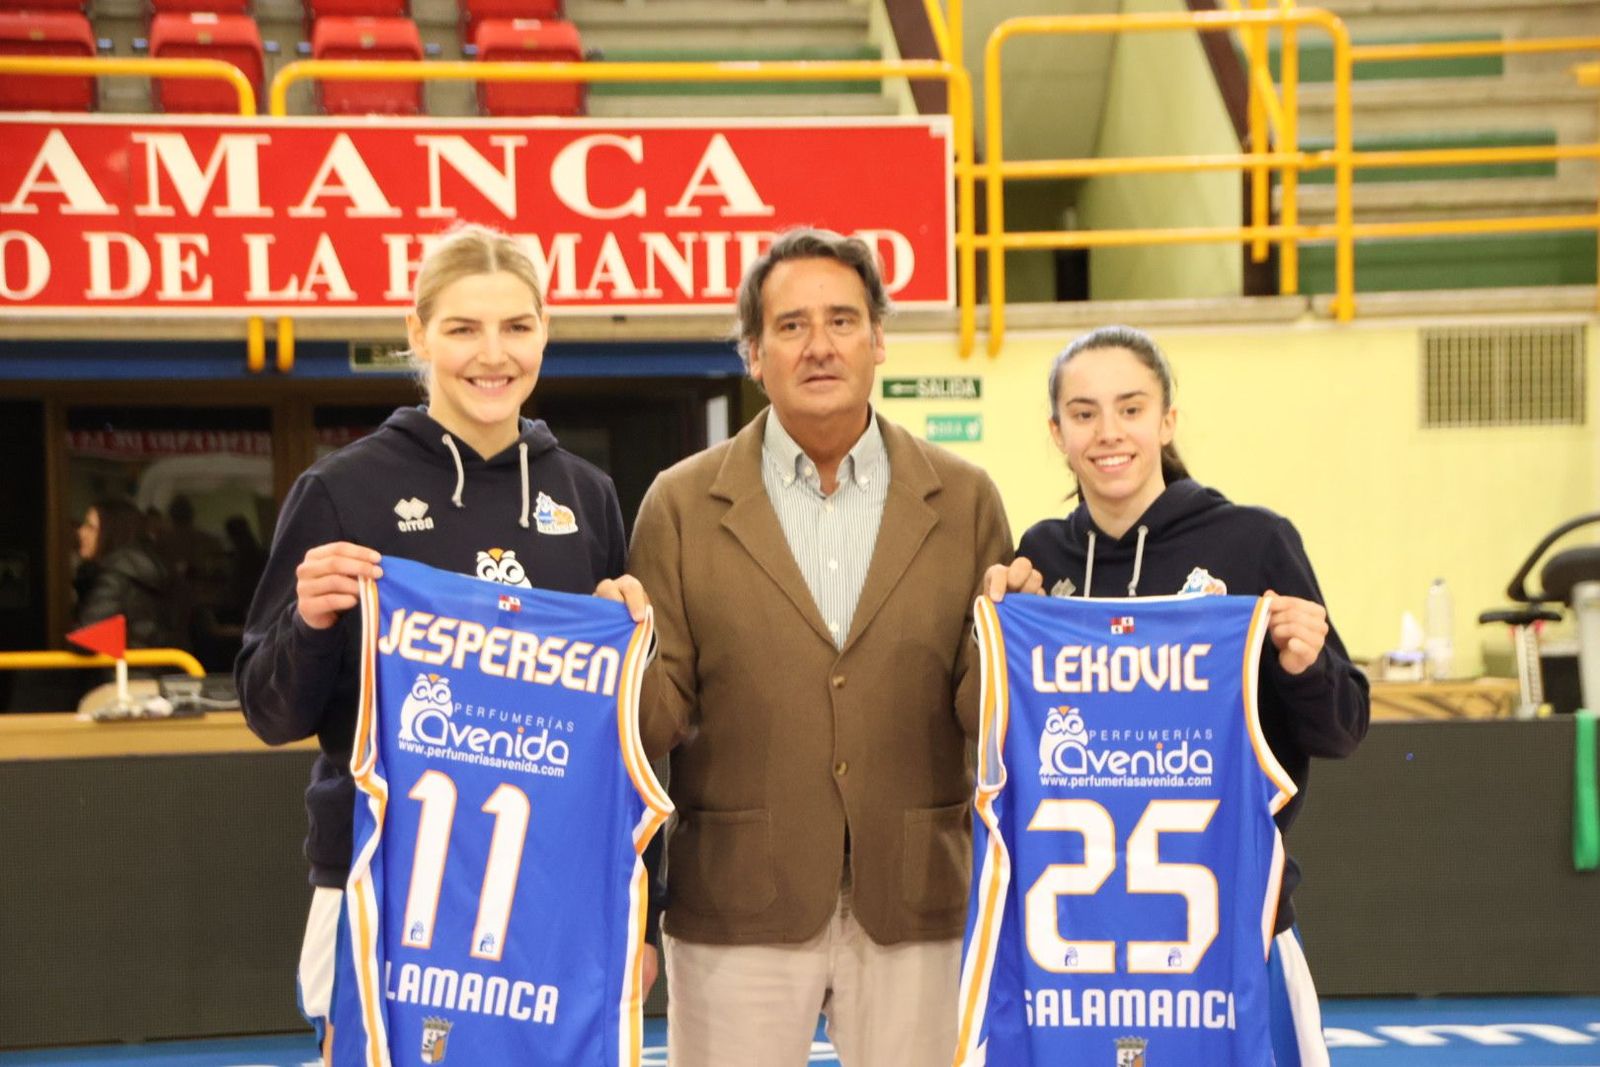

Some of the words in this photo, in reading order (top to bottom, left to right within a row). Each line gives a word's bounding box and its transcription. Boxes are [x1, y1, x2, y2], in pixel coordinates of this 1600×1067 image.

[0, 128, 774, 219] AMANCA
[82, 231, 213, 301] DE
[242, 233, 357, 301] LA
[378, 608, 620, 697] JESPERSEN
[1031, 643, 1212, 694] LEKOVIC
[415, 709, 570, 766] avenida
[454, 702, 575, 733] PERFUMERÍAS
[1089, 727, 1213, 741] PERFUMERÍAS
[398, 739, 565, 777] www.perfumeriasavenida.com
[1040, 774, 1212, 789] www.perfumeriasavenida.com
[1055, 740, 1213, 775] avenida
[401, 769, 531, 962] 11
[1025, 799, 1221, 974] 25
